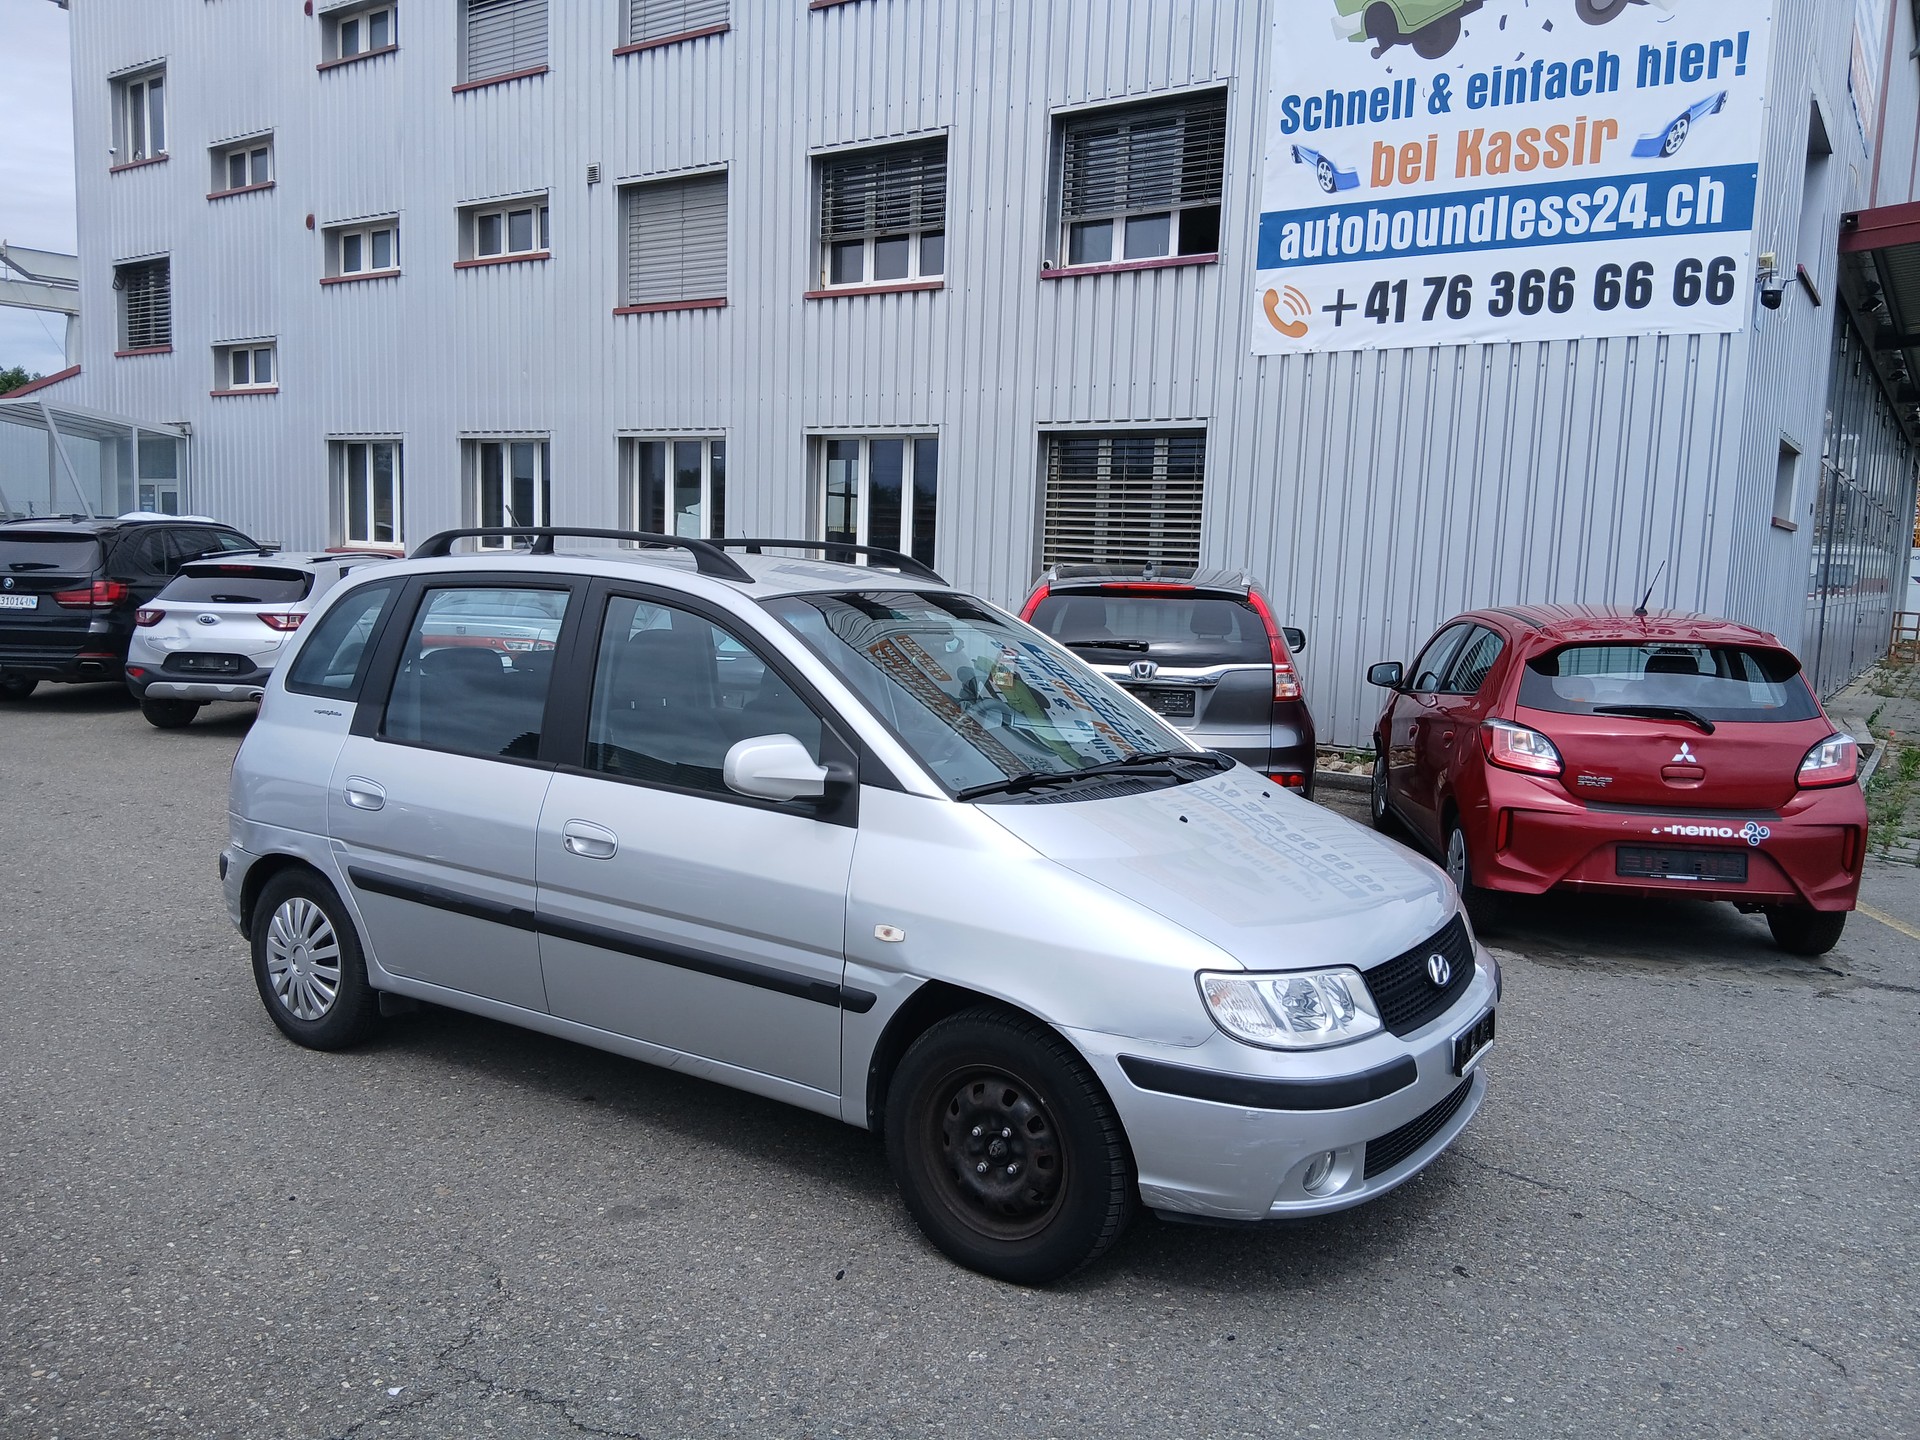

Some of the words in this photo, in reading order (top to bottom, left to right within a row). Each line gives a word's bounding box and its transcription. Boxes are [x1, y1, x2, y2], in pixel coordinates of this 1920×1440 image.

[1280, 78, 1417, 135] Schnell
[1428, 72, 1454, 115] &
[1466, 50, 1620, 111] einfach
[1636, 30, 1751, 89] hier!
[1370, 133, 1437, 189] bei
[1455, 113, 1619, 180] Kassir
[1279, 176, 1727, 261] autoboundless24.ch
[1422, 274, 1473, 322] 76
[1488, 266, 1576, 318] 366
[1593, 261, 1655, 312] 66
[1672, 256, 1737, 307] 66
